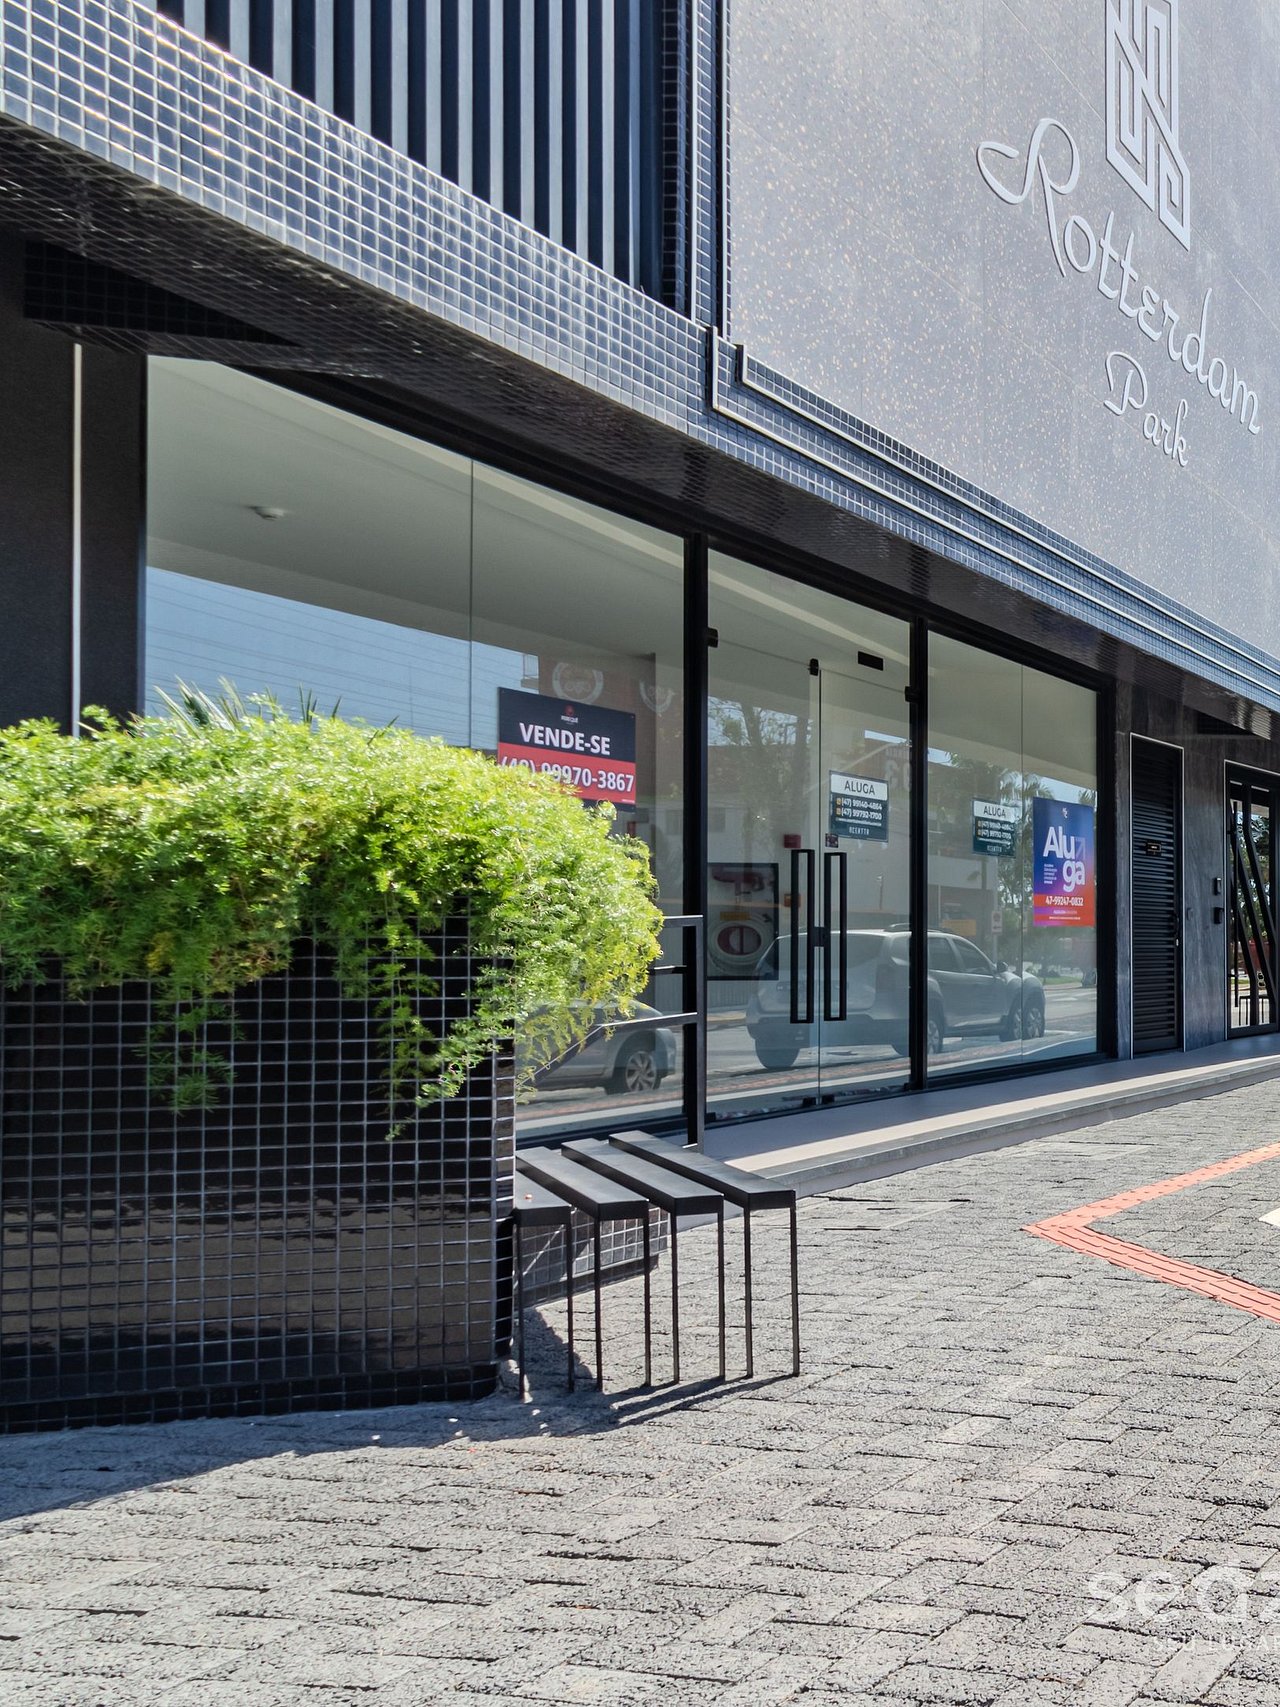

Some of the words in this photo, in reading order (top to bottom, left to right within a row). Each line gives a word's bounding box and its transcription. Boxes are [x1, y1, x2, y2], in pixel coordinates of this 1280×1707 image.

[976, 118, 1261, 435] Rotterdam
[1103, 351, 1188, 467] Park
[519, 722, 611, 756] VENDE-SE
[844, 780, 876, 795] ALUGA
[983, 806, 1006, 818] ALUGA
[1043, 826, 1075, 859] Alu
[1062, 859, 1086, 893] ga
